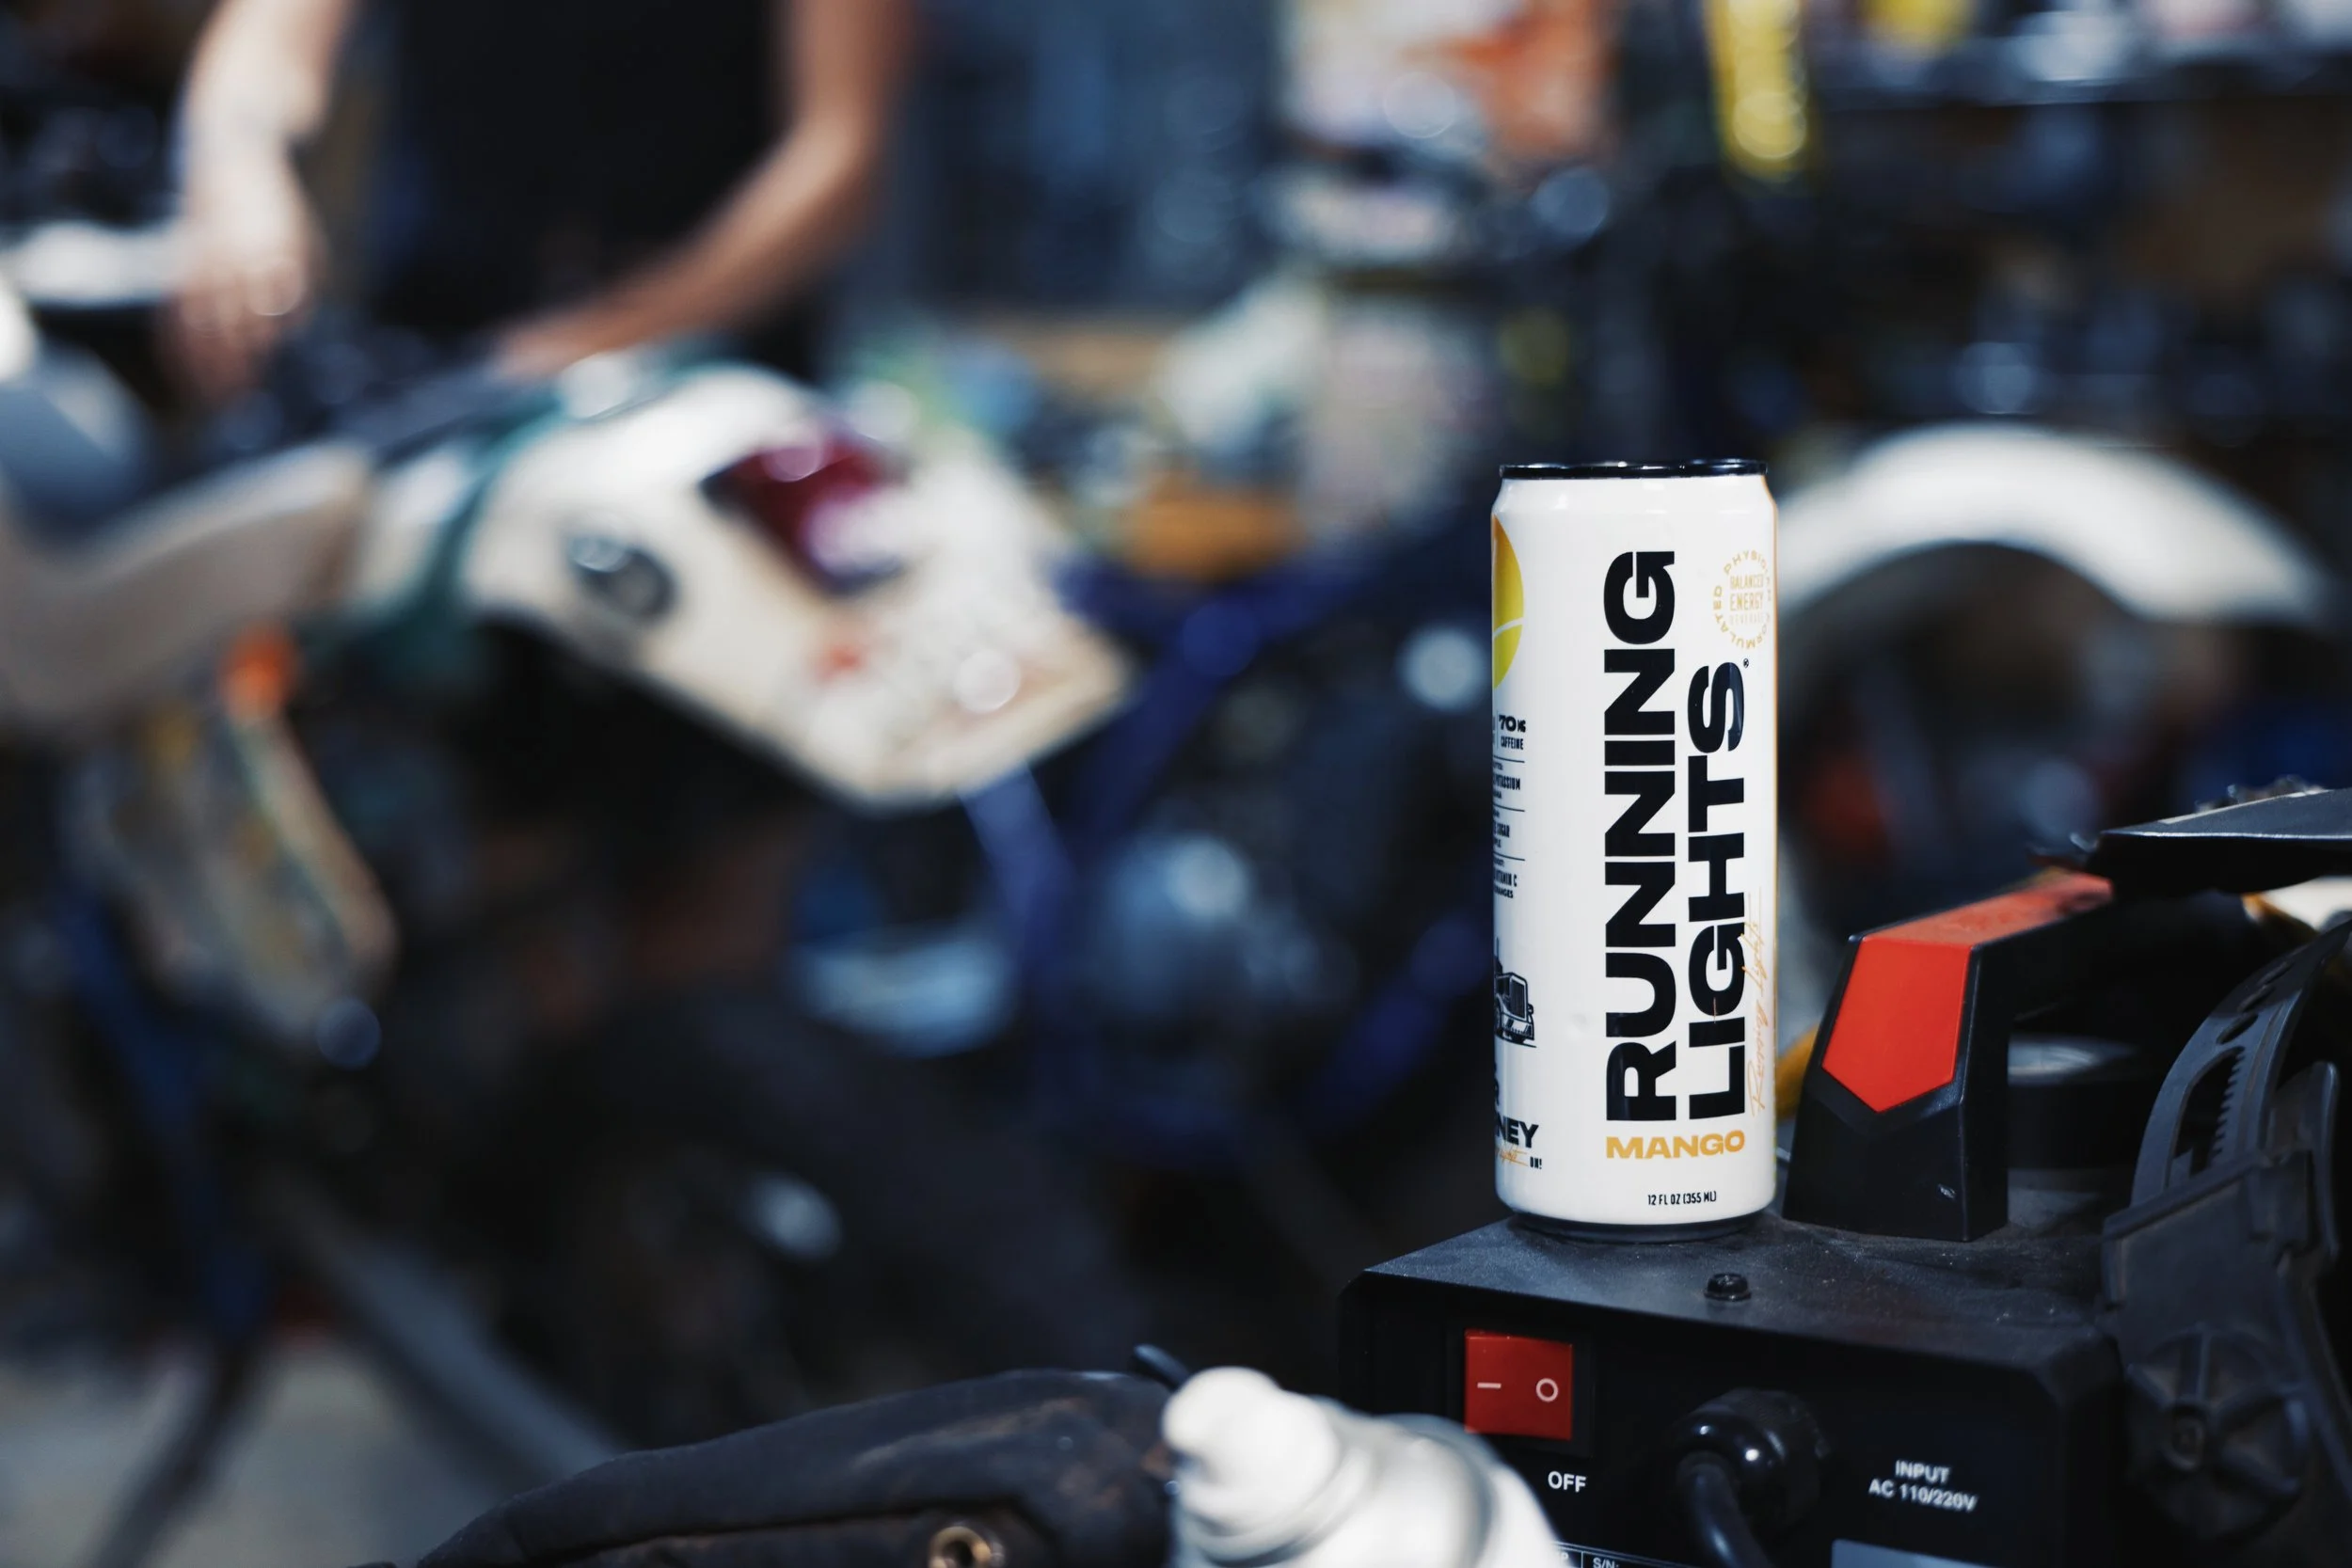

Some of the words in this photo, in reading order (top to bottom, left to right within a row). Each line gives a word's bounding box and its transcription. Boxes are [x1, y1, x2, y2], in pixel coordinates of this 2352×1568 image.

[1730, 593, 1764, 611] ENERGY
[1501, 736, 1523, 751] CAFFEINE
[1603, 550, 1677, 1121] RUNNING
[1606, 1129, 1745, 1159] MANGO
[1647, 1194, 1657, 1206] 12
[1659, 1194, 1668, 1205] FL
[1670, 1193, 1680, 1205] OZ
[1683, 1191, 1702, 1204] (355
[1704, 1190, 1717, 1203] ML)
[1548, 1470, 1587, 1493] OFF
[1895, 1459, 1950, 1484] INPUT
[1868, 1478, 1895, 1499] AC
[1899, 1482, 1979, 1513] 110/220V
